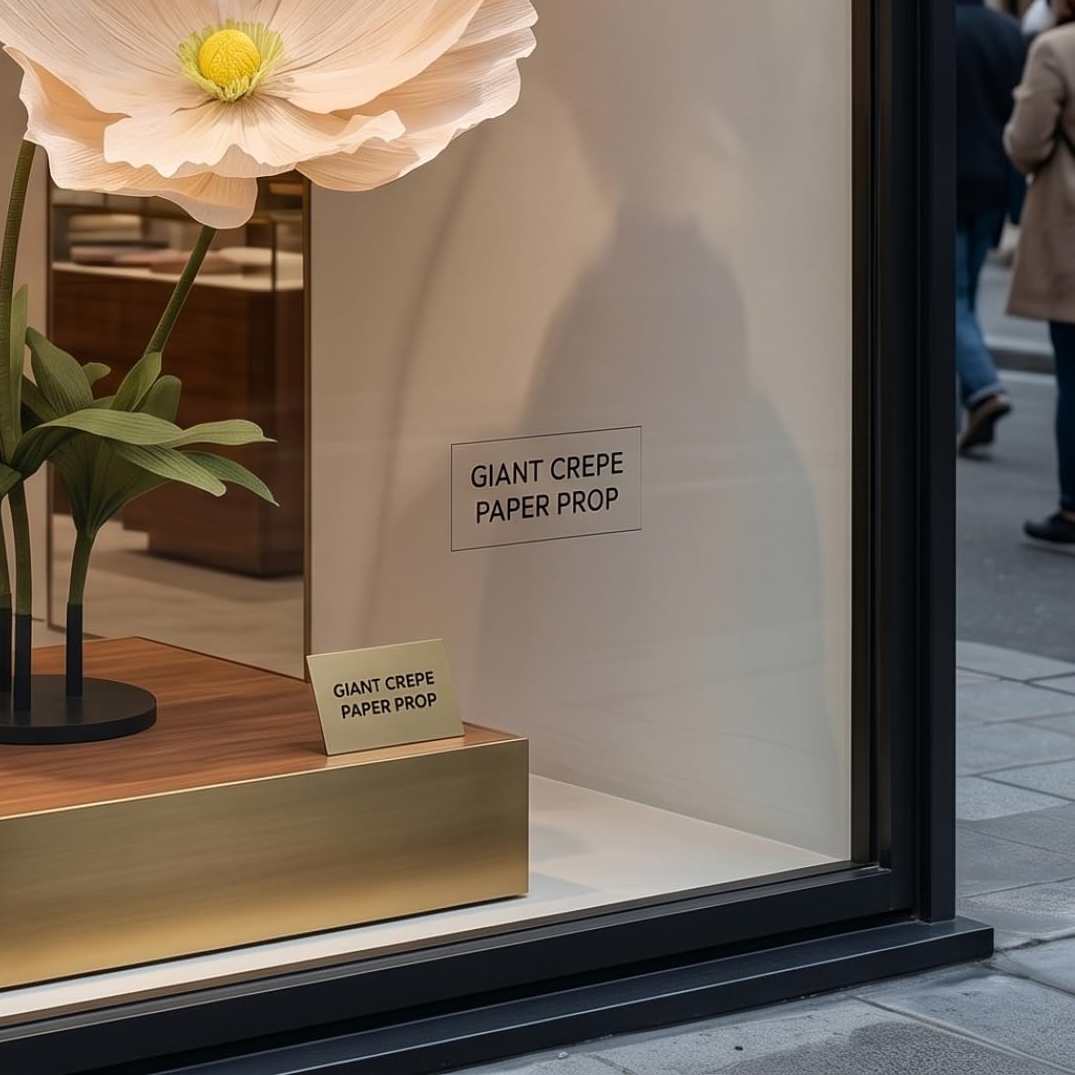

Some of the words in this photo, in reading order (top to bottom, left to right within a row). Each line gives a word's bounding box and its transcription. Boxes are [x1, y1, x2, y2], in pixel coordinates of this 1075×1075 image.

[471, 460, 543, 487] GIANT
[551, 452, 623, 480] CREPE
[477, 495, 549, 523] PAPER
[558, 488, 618, 514] PROP
[333, 678, 381, 698] GIANT
[385, 671, 435, 691] CREPE
[340, 698, 391, 719] PAPER
[394, 692, 437, 712] PROP
